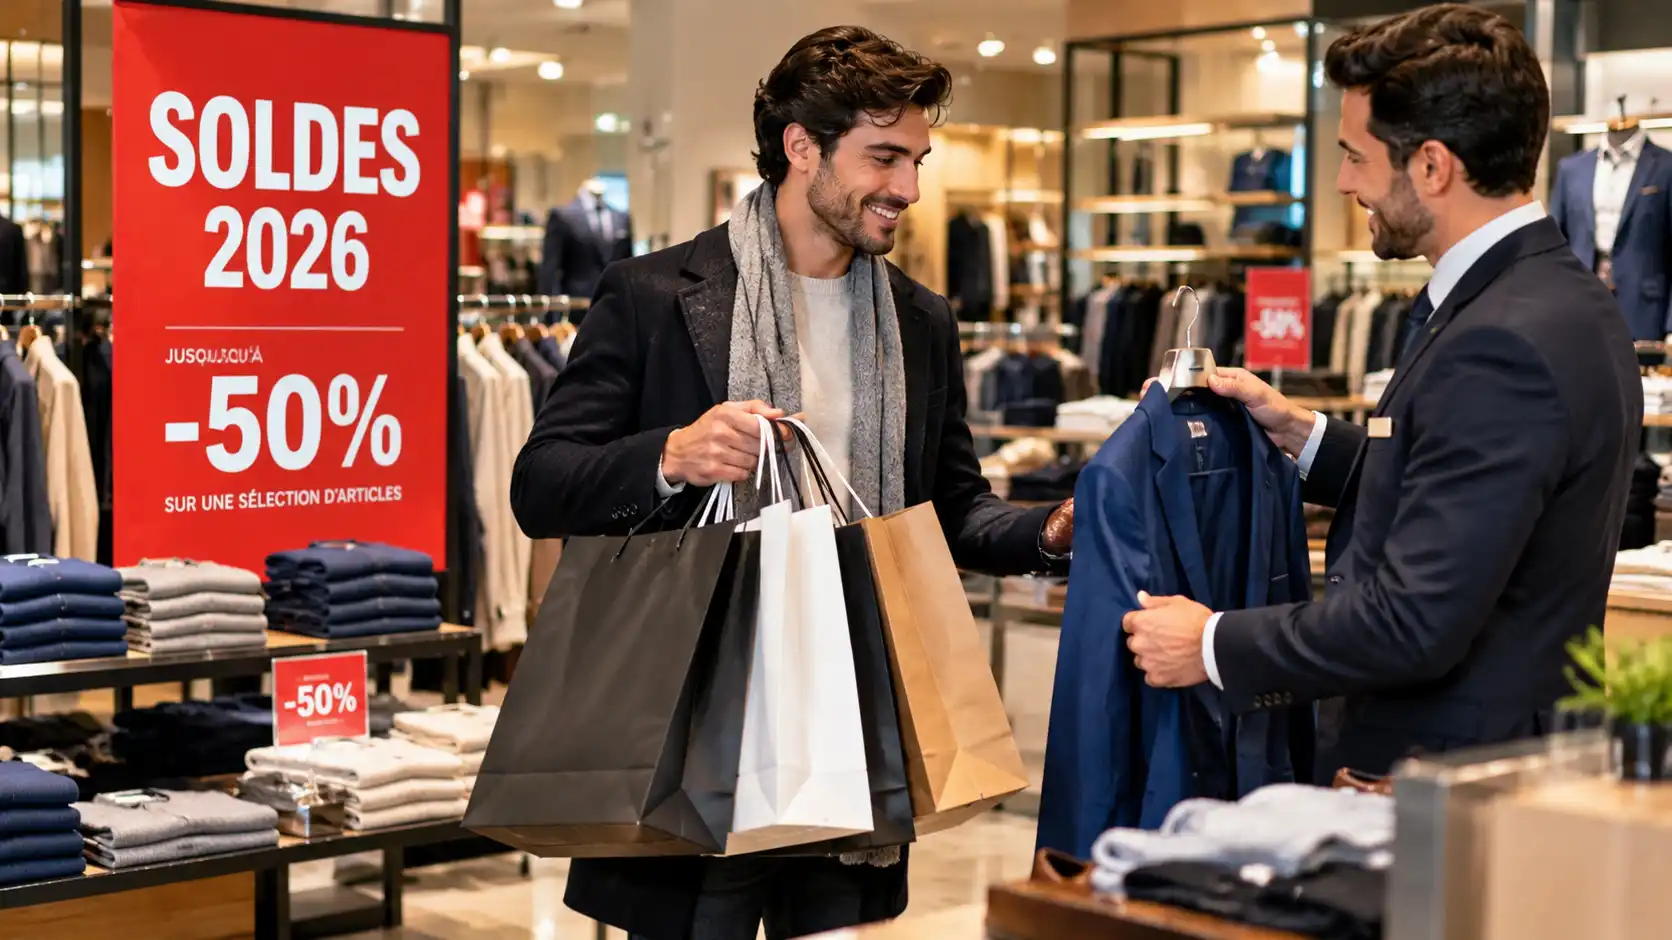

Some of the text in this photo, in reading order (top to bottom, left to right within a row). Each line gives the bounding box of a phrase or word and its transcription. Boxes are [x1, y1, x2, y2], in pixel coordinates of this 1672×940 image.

[148, 91, 421, 198] SOLDES
[204, 206, 370, 292] 2026
[165, 374, 402, 473] -50%
[165, 485, 402, 513] SUR UNE SÉLECTION D'ARTICLES
[284, 681, 358, 718] -50%
